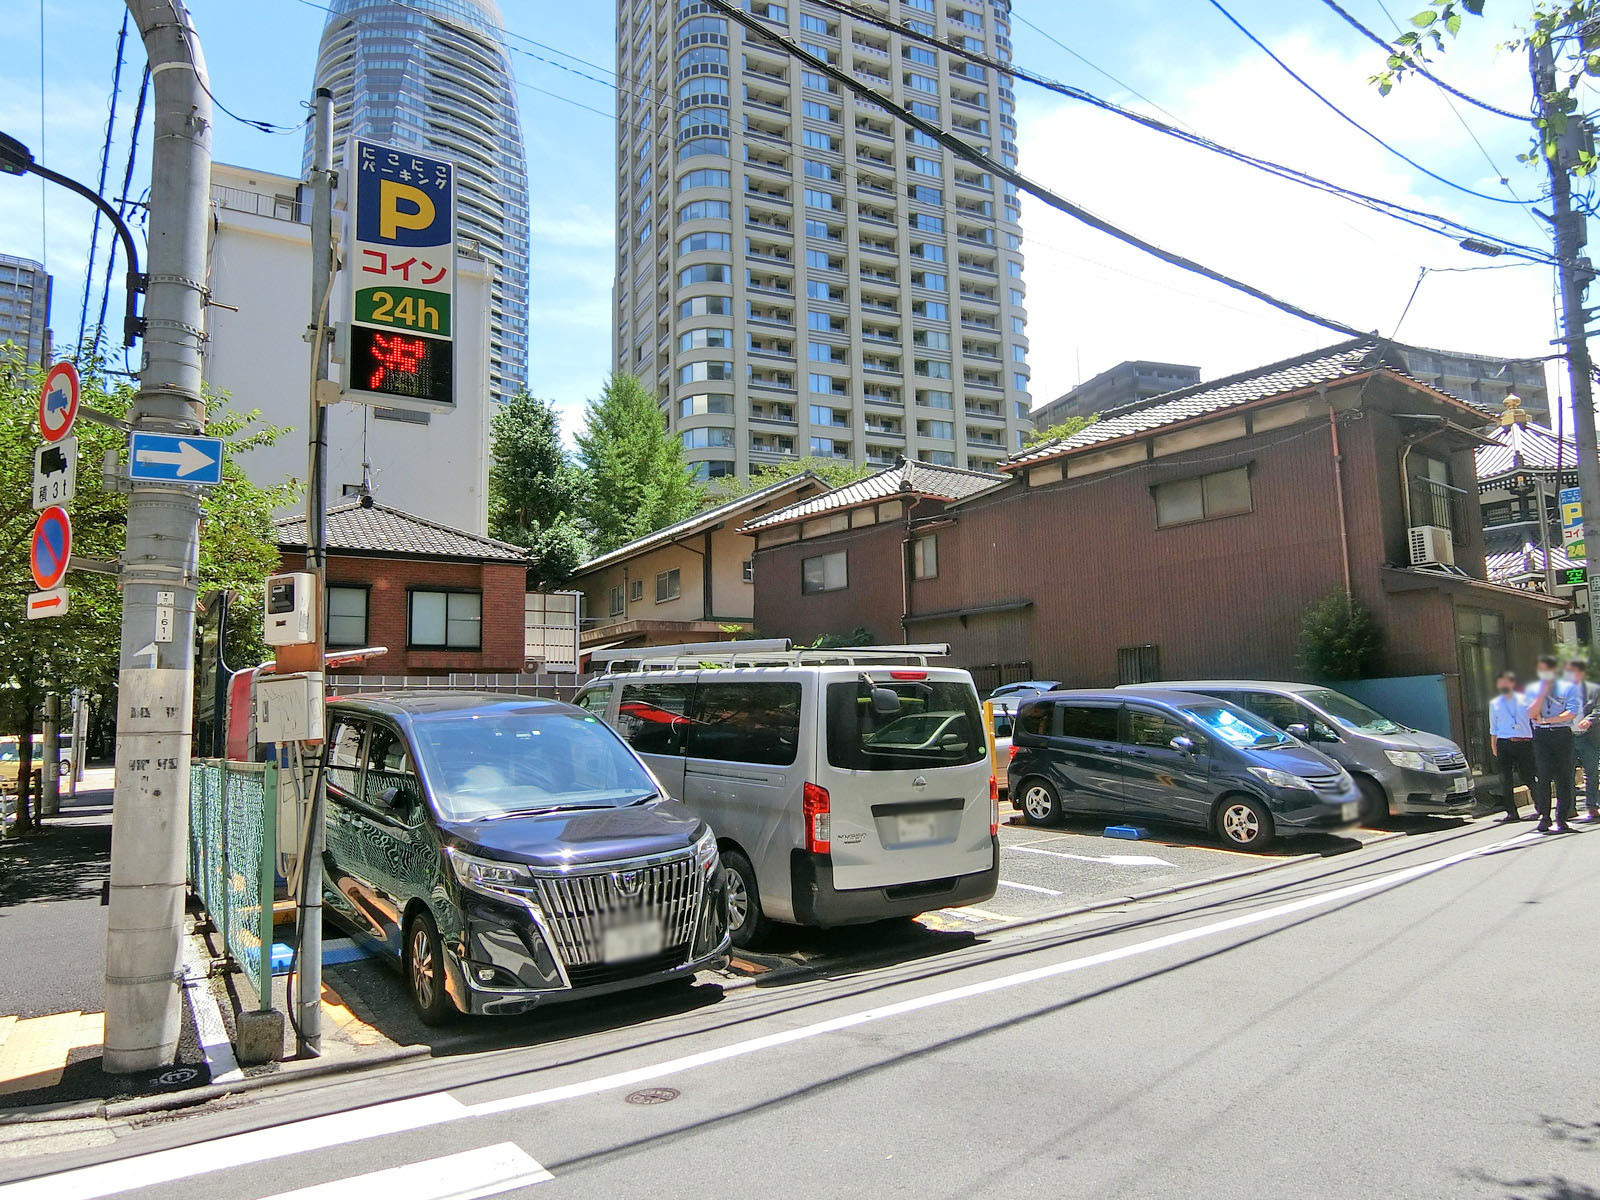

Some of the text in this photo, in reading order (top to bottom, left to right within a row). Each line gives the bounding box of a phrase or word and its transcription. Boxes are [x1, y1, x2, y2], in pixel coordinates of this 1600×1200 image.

[362, 146, 447, 178] にこにこ
[362, 160, 447, 190] パーキング
[380, 178, 436, 240] P
[362, 249, 447, 285] コイン
[371, 291, 439, 330] 24h
[1562, 502, 1583, 526] P
[1565, 528, 1585, 538] コイ
[1566, 568, 1584, 584] 空
